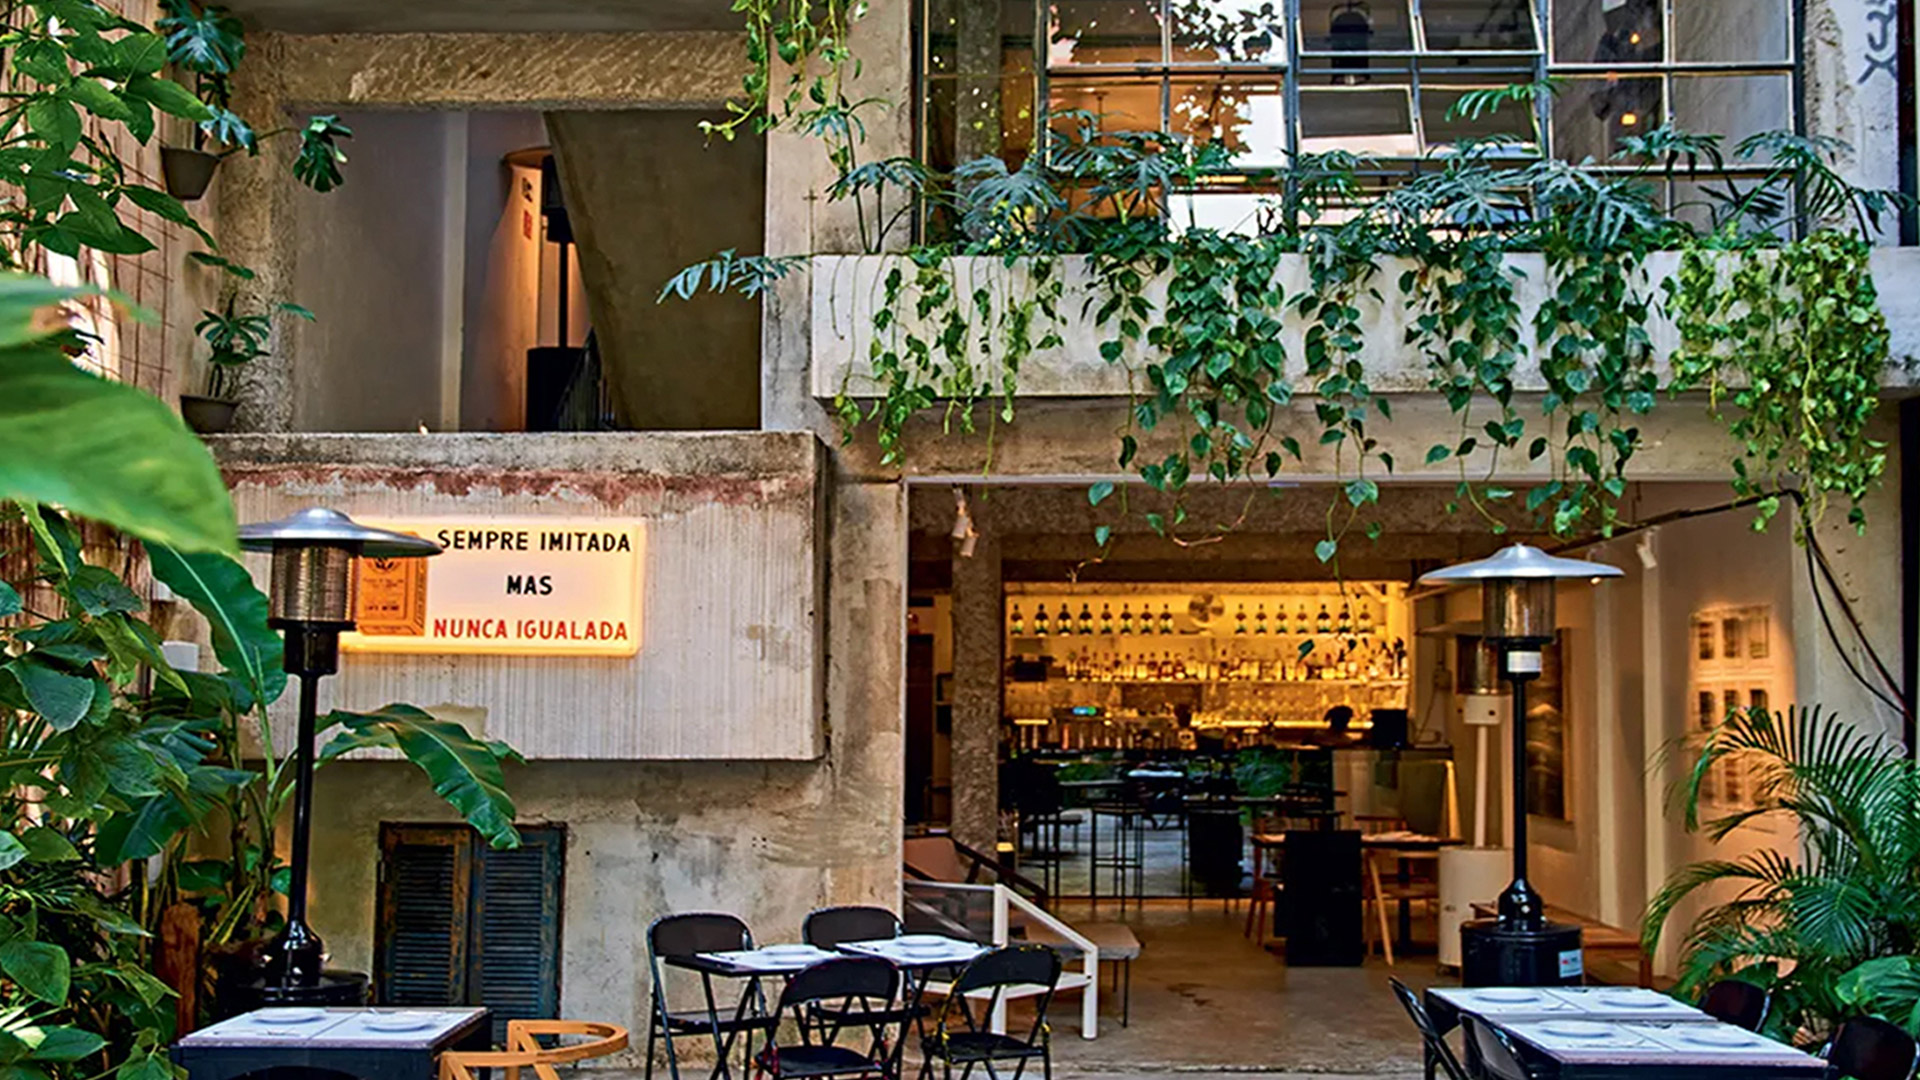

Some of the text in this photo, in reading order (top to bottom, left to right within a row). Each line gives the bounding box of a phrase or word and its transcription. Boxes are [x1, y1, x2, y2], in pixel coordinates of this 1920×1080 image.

[437, 529, 631, 552] SEMPRE IMITADA
[506, 575, 553, 595] MAS
[433, 618, 508, 639] NUNCA
[516, 619, 628, 640] IGUALADA
